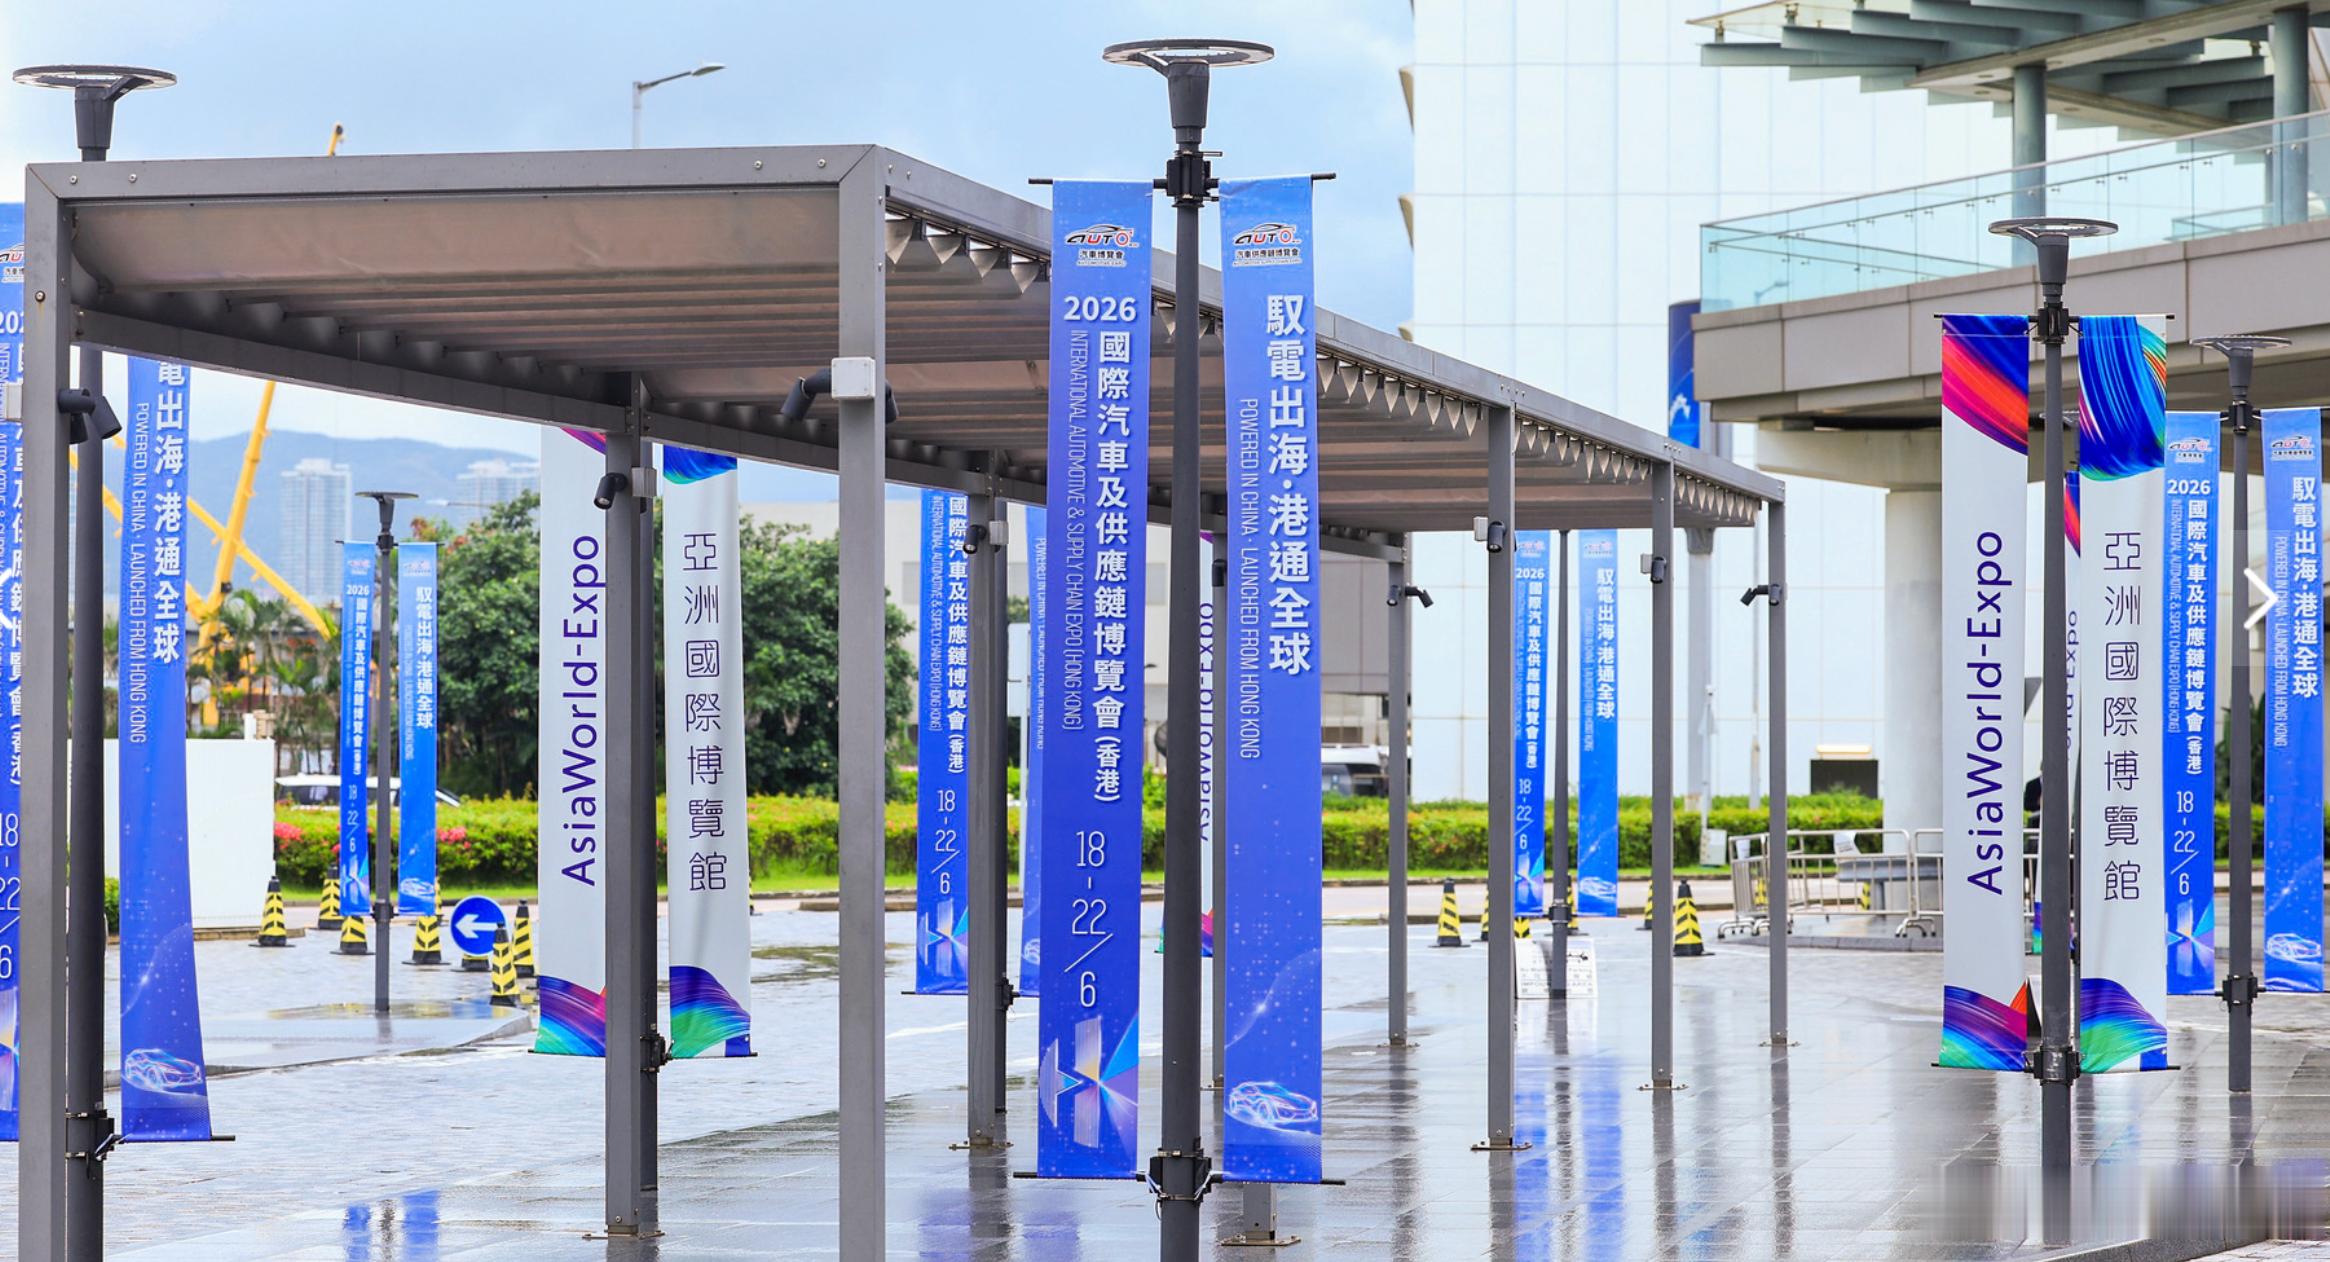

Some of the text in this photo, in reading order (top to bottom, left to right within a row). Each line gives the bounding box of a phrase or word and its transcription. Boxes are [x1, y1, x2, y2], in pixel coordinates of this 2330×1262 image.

[1064, 296, 1137, 322] 2026
[133, 402, 151, 470] POWERED
[1240, 399, 1259, 468] POWERED
[133, 473, 147, 487] IN
[1240, 473, 1259, 487] IN
[1266, 294, 1311, 676] 馭電出海·港通全球
[2167, 479, 2211, 494] 2026
[131, 490, 147, 531] CHINA
[153, 361, 186, 666] 電出海·港通全球
[1240, 491, 1260, 535] CHINA
[2171, 500, 2183, 553] INTERNATIONAL
[1062, 330, 1088, 730] INTERNATIONAL AUTOMOTIVE & SUPPLY CHAIN EXPO (HONG KONG)
[931, 552, 943, 599] AUTOMOTIVE
[1516, 568, 1545, 580] 2026
[2275, 536, 2289, 578] POWERED
[130, 543, 146, 617] LAUNCHED
[346, 584, 370, 596] 2026
[1240, 548, 1259, 625] LAUNCHED
[2170, 554, 2182, 601] AUTOMOTIVE
[2275, 580, 2289, 589] IN
[2292, 477, 2319, 699] 馭電出海·港通全球
[129, 620, 146, 660] FROM
[930, 609, 942, 637] SUPPLY
[2169, 611, 2181, 640] SUPPLY
[1240, 629, 1260, 670] FROM
[2275, 623, 2289, 669] LAUNCHED
[129, 663, 147, 701] HONG
[929, 662, 942, 682] EXPO
[2168, 664, 2181, 684] EXPO
[2274, 671, 2288, 695] FROM
[561, 535, 606, 887] AsiaWorld-Expo
[683, 533, 727, 892] 亞洲國際博覽館
[1240, 674, 1260, 714] HONG
[1966, 531, 2012, 895] AsiaWorld-Expo
[2274, 697, 2288, 721] HONG
[129, 705, 147, 744] KONG
[2103, 532, 2140, 902] 亞洲國際博覽館
[2274, 722, 2288, 746] KONG
[1240, 718, 1260, 759] KONG
[937, 789, 956, 812] 18
[2176, 791, 2194, 813] 18
[934, 829, 957, 852] 22
[1075, 831, 1106, 868] 18
[2173, 831, 2196, 853] 22
[939, 872, 950, 894] 6
[2178, 872, 2190, 895] 6
[1071, 899, 1108, 935] 22
[1079, 971, 1097, 1008] 6
